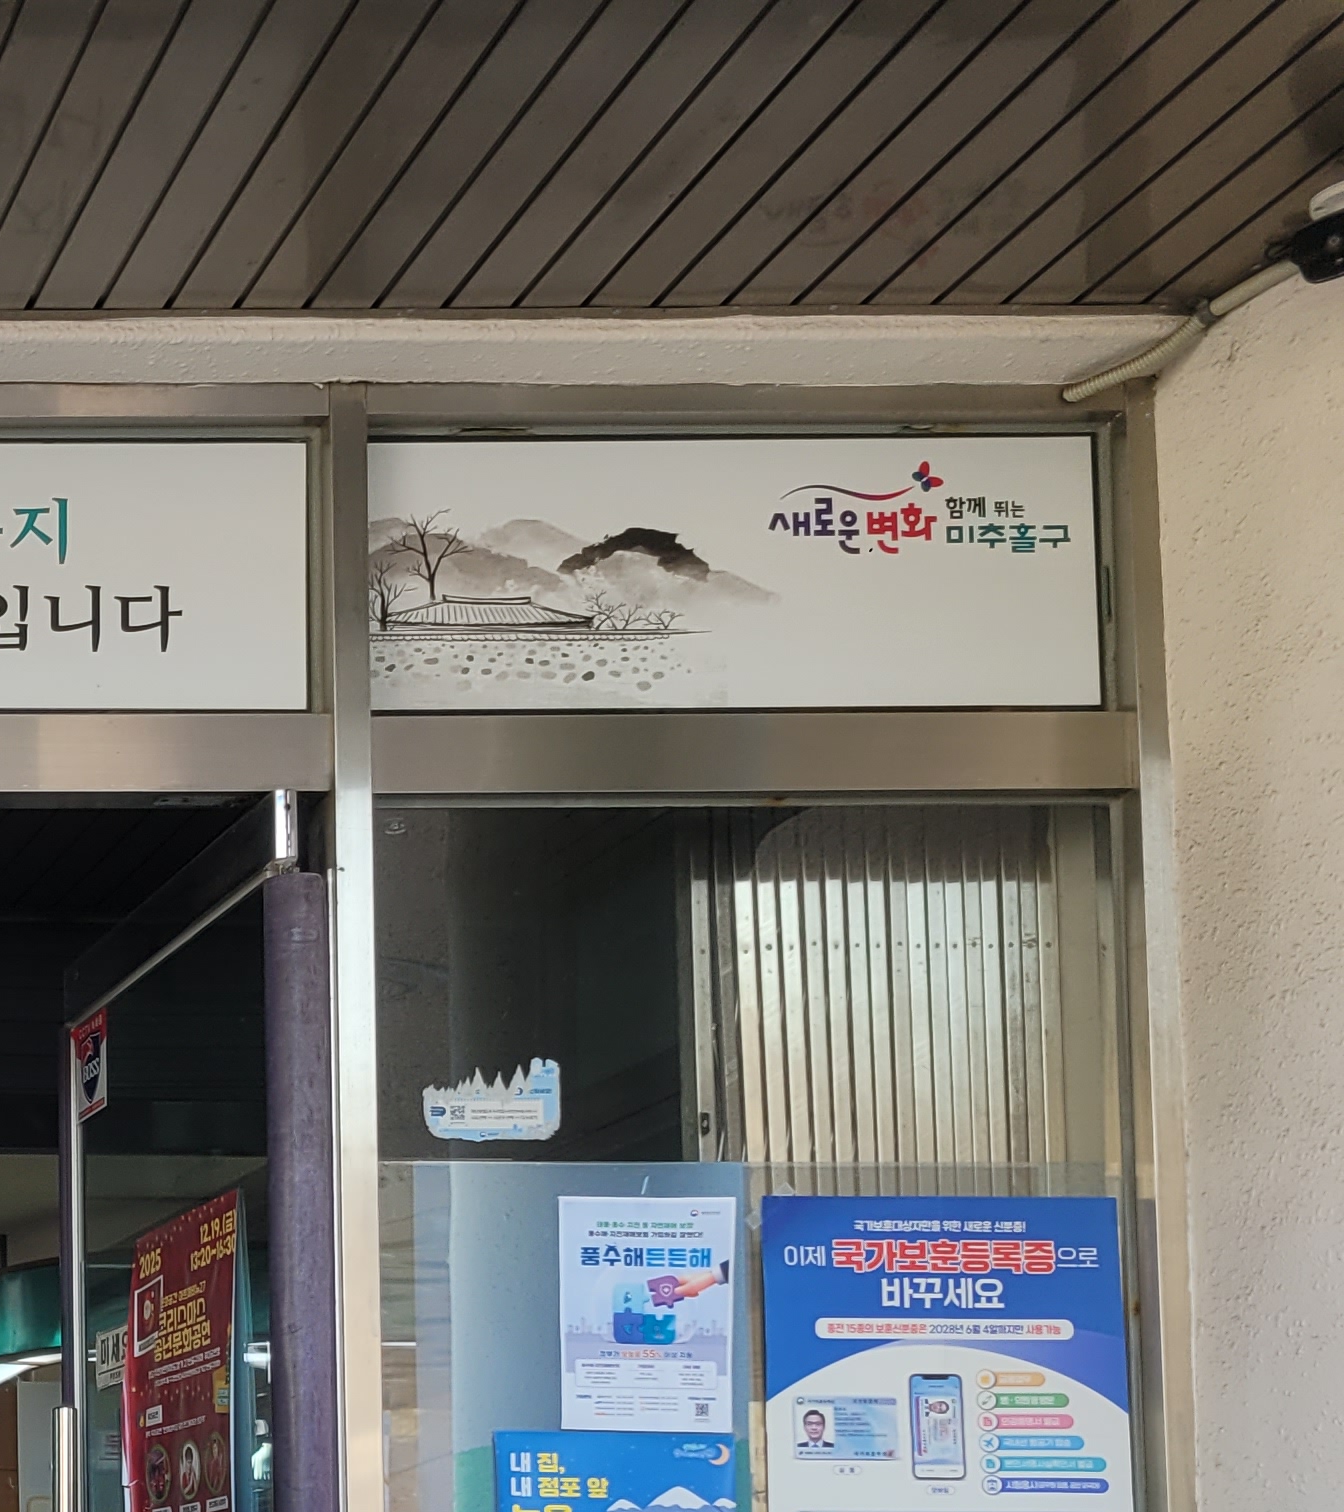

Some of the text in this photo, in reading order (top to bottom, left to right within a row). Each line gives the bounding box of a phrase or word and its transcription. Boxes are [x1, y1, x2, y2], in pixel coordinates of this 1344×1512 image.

[945, 495, 1025, 519] 함께 뛰는
[769, 497, 938, 555] 새로운 변화
[945, 523, 1072, 553] 미추홀구
[139, 1248, 162, 1279] 2025
[784, 1245, 826, 1268] 이제
[881, 1278, 1005, 1309] 바꾸세요
[510, 1452, 565, 1475] 내 집,
[510, 1477, 609, 1498] 내 점포 앞
